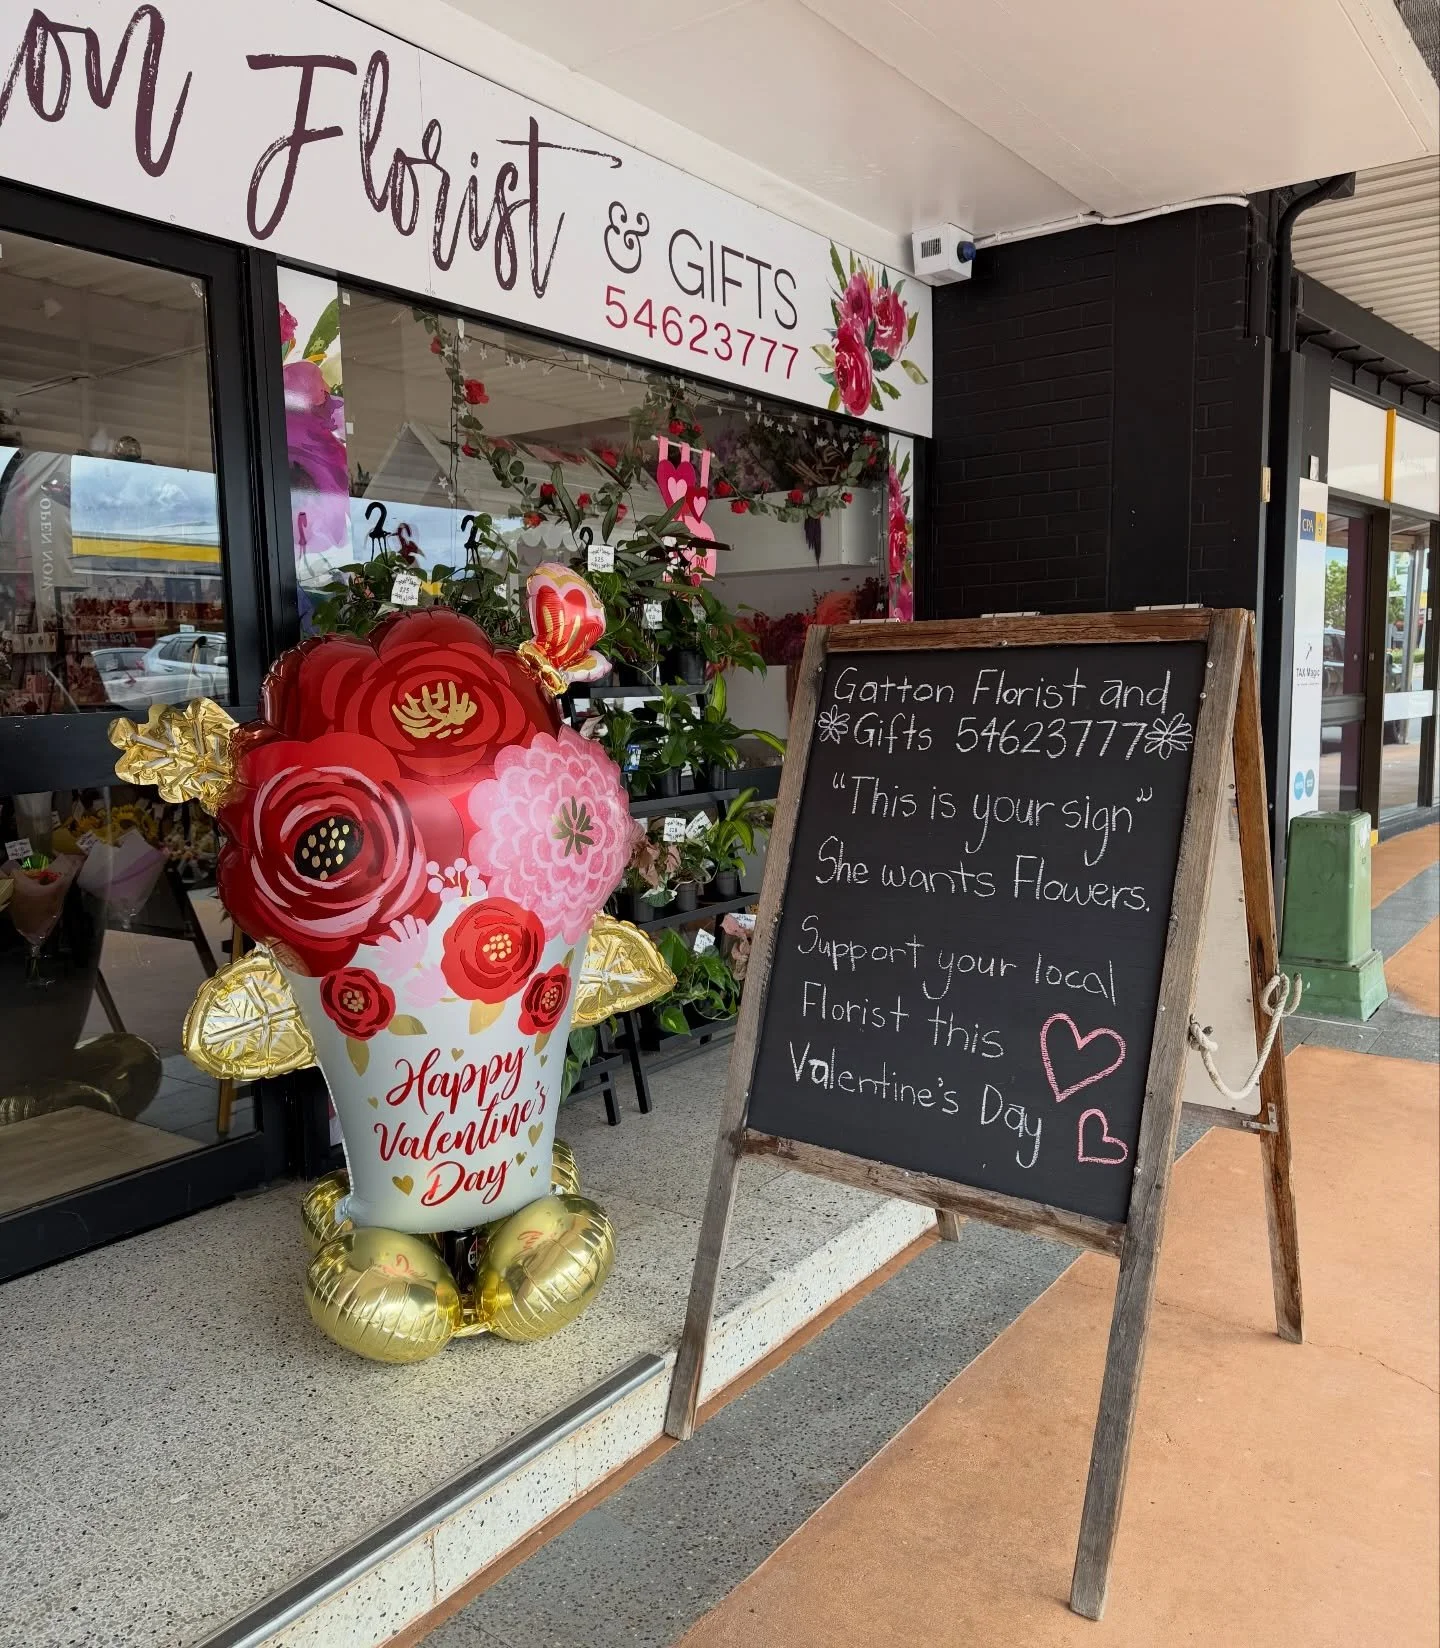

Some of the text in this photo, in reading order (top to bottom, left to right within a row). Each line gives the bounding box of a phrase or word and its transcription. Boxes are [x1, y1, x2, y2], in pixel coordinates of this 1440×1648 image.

[246, 50, 622, 298] Florist
[604, 201, 649, 274] &
[668, 228, 797, 330] GIFTS
[605, 285, 799, 380] 54623777
[1302, 518, 1314, 533] CPA
[696, 557, 708, 568] DAY
[833, 667, 1170, 714] Gatton Florist and
[853, 712, 1148, 761] Gifts 54623777
[930, 787, 957, 821] is
[964, 793, 1055, 855] your
[815, 836, 1150, 912] She wants Flowers.
[797, 915, 1118, 1006] Support your local
[802, 981, 1004, 1059] Florist this
[386, 1046, 529, 1115] Happy
[789, 1041, 1043, 1169] Valentine's Day
[374, 1080, 549, 1161] Valentine's
[420, 1158, 514, 1207] Day
